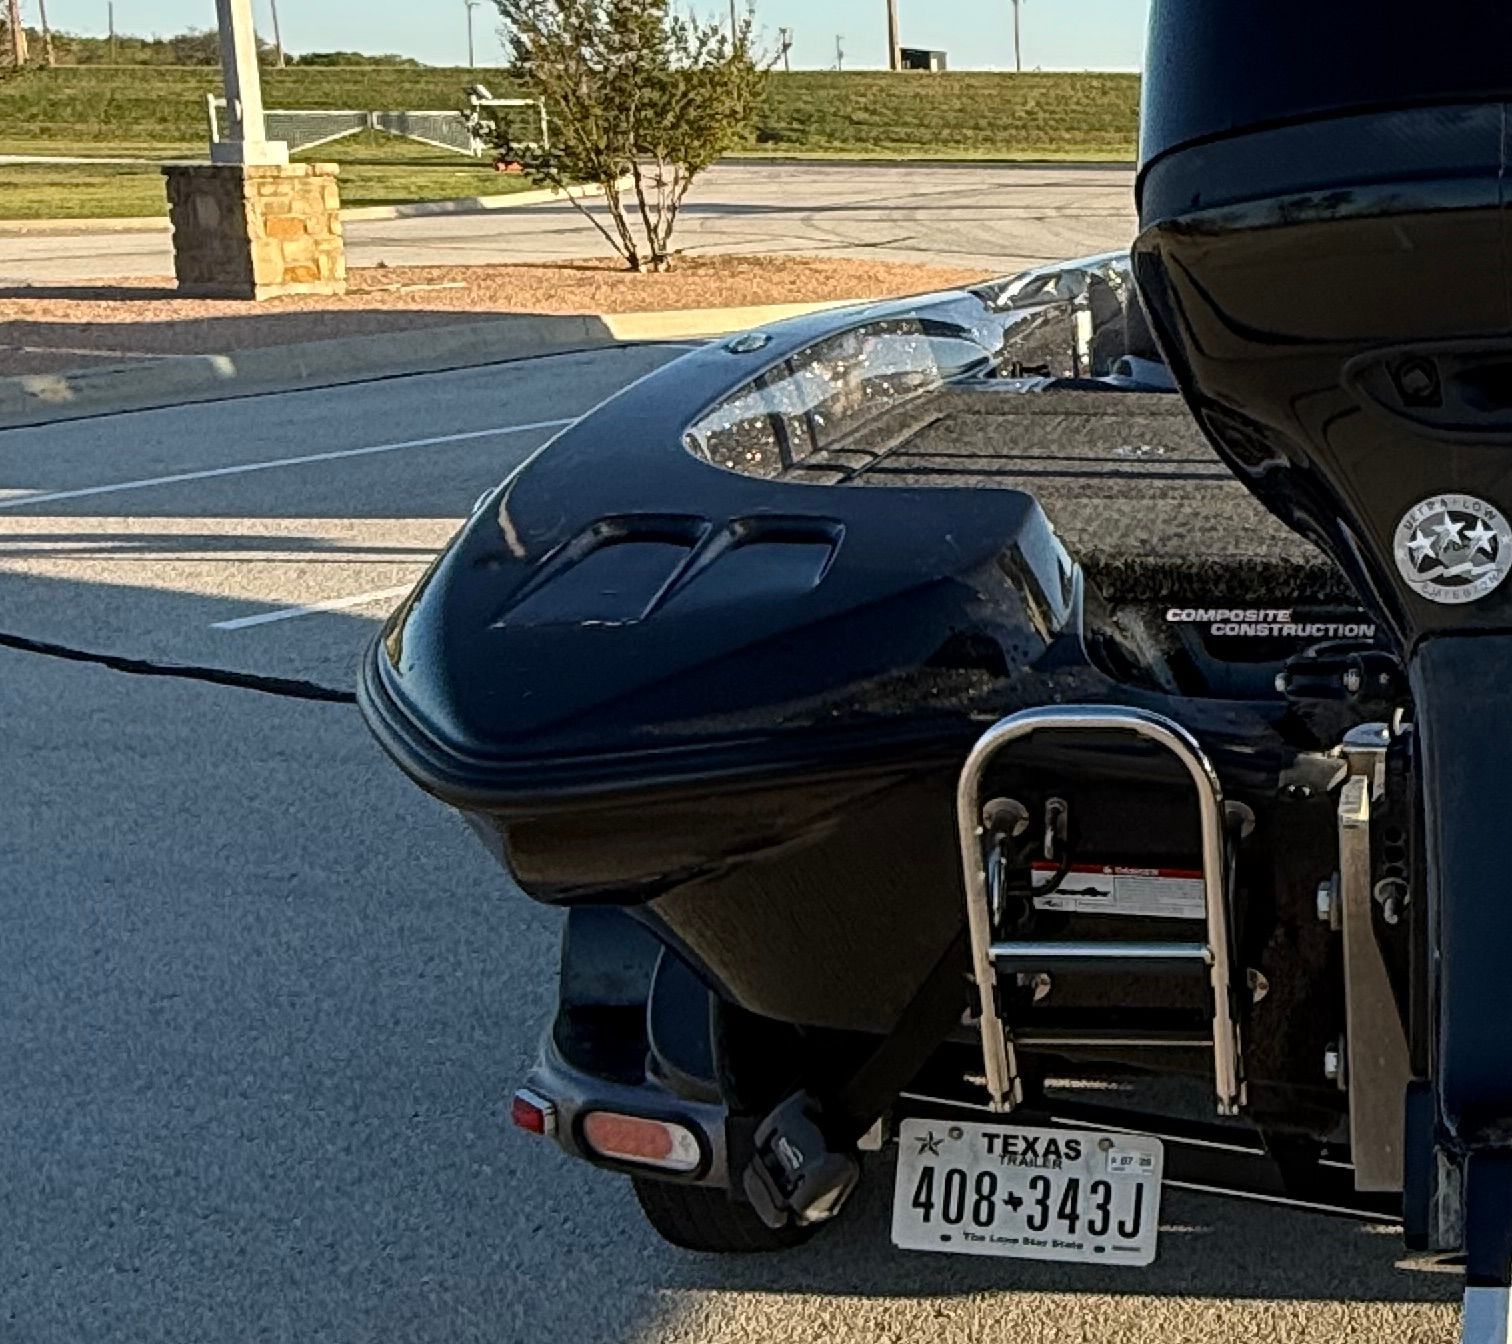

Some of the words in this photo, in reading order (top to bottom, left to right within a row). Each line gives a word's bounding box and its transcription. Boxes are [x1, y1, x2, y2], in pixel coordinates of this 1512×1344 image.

[1166, 608, 1293, 623] COMPOSITE
[1210, 623, 1376, 638] CONSTRUCTION
[981, 1132, 1082, 1161] TEXAS
[999, 1153, 1062, 1170] TRAILER
